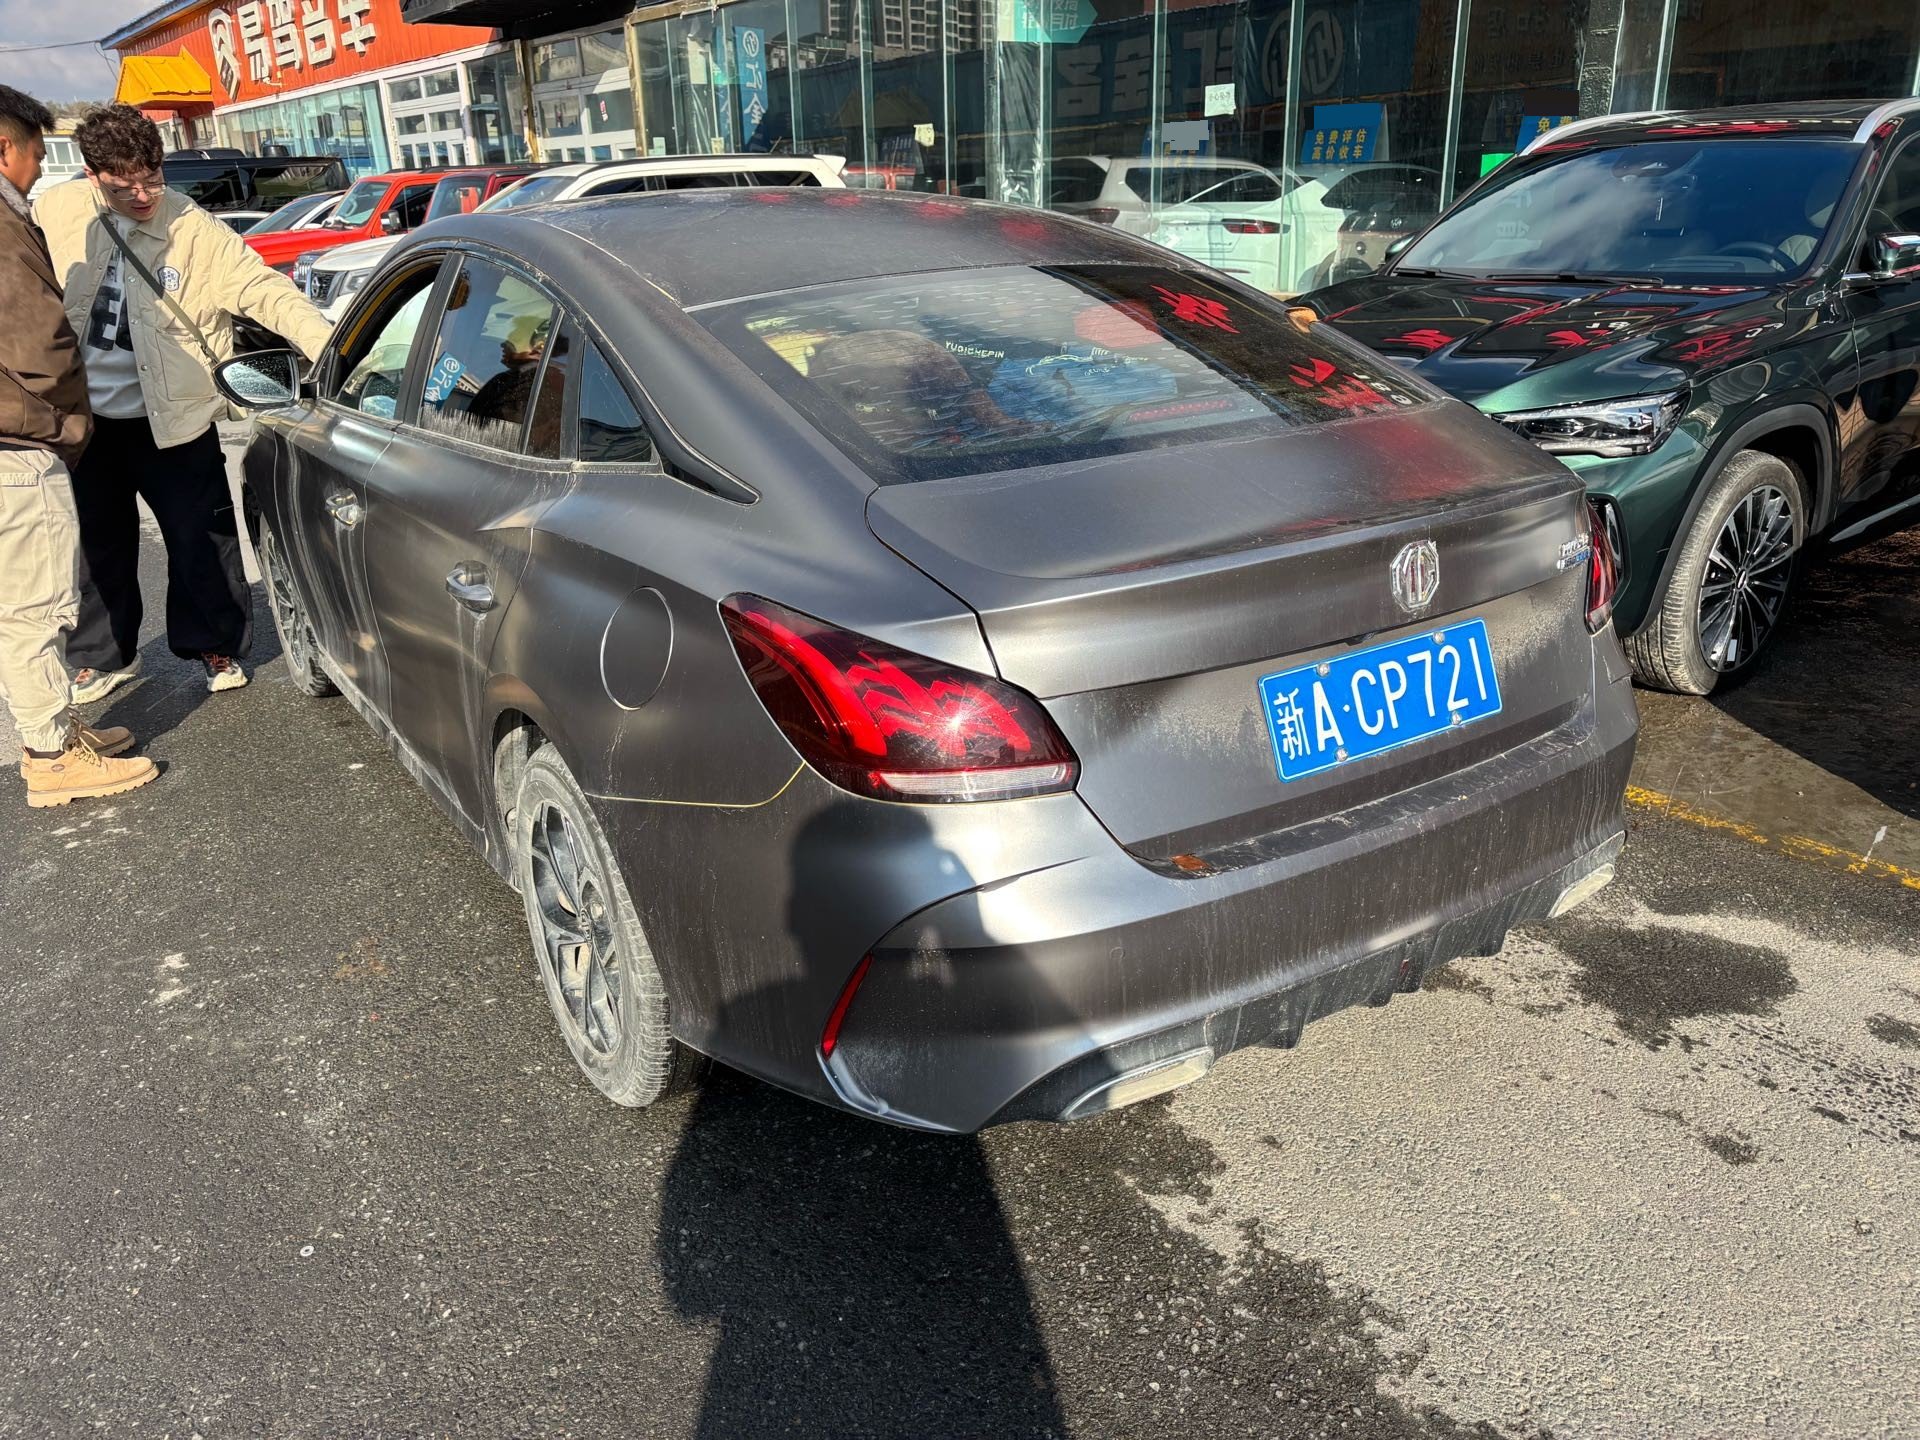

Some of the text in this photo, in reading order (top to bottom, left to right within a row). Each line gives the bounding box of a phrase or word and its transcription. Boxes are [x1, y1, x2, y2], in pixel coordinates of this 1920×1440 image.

[1315, 128, 1367, 145] 免费评估
[1311, 144, 1364, 161] 高价收车
[1396, 546, 1436, 602] MG
